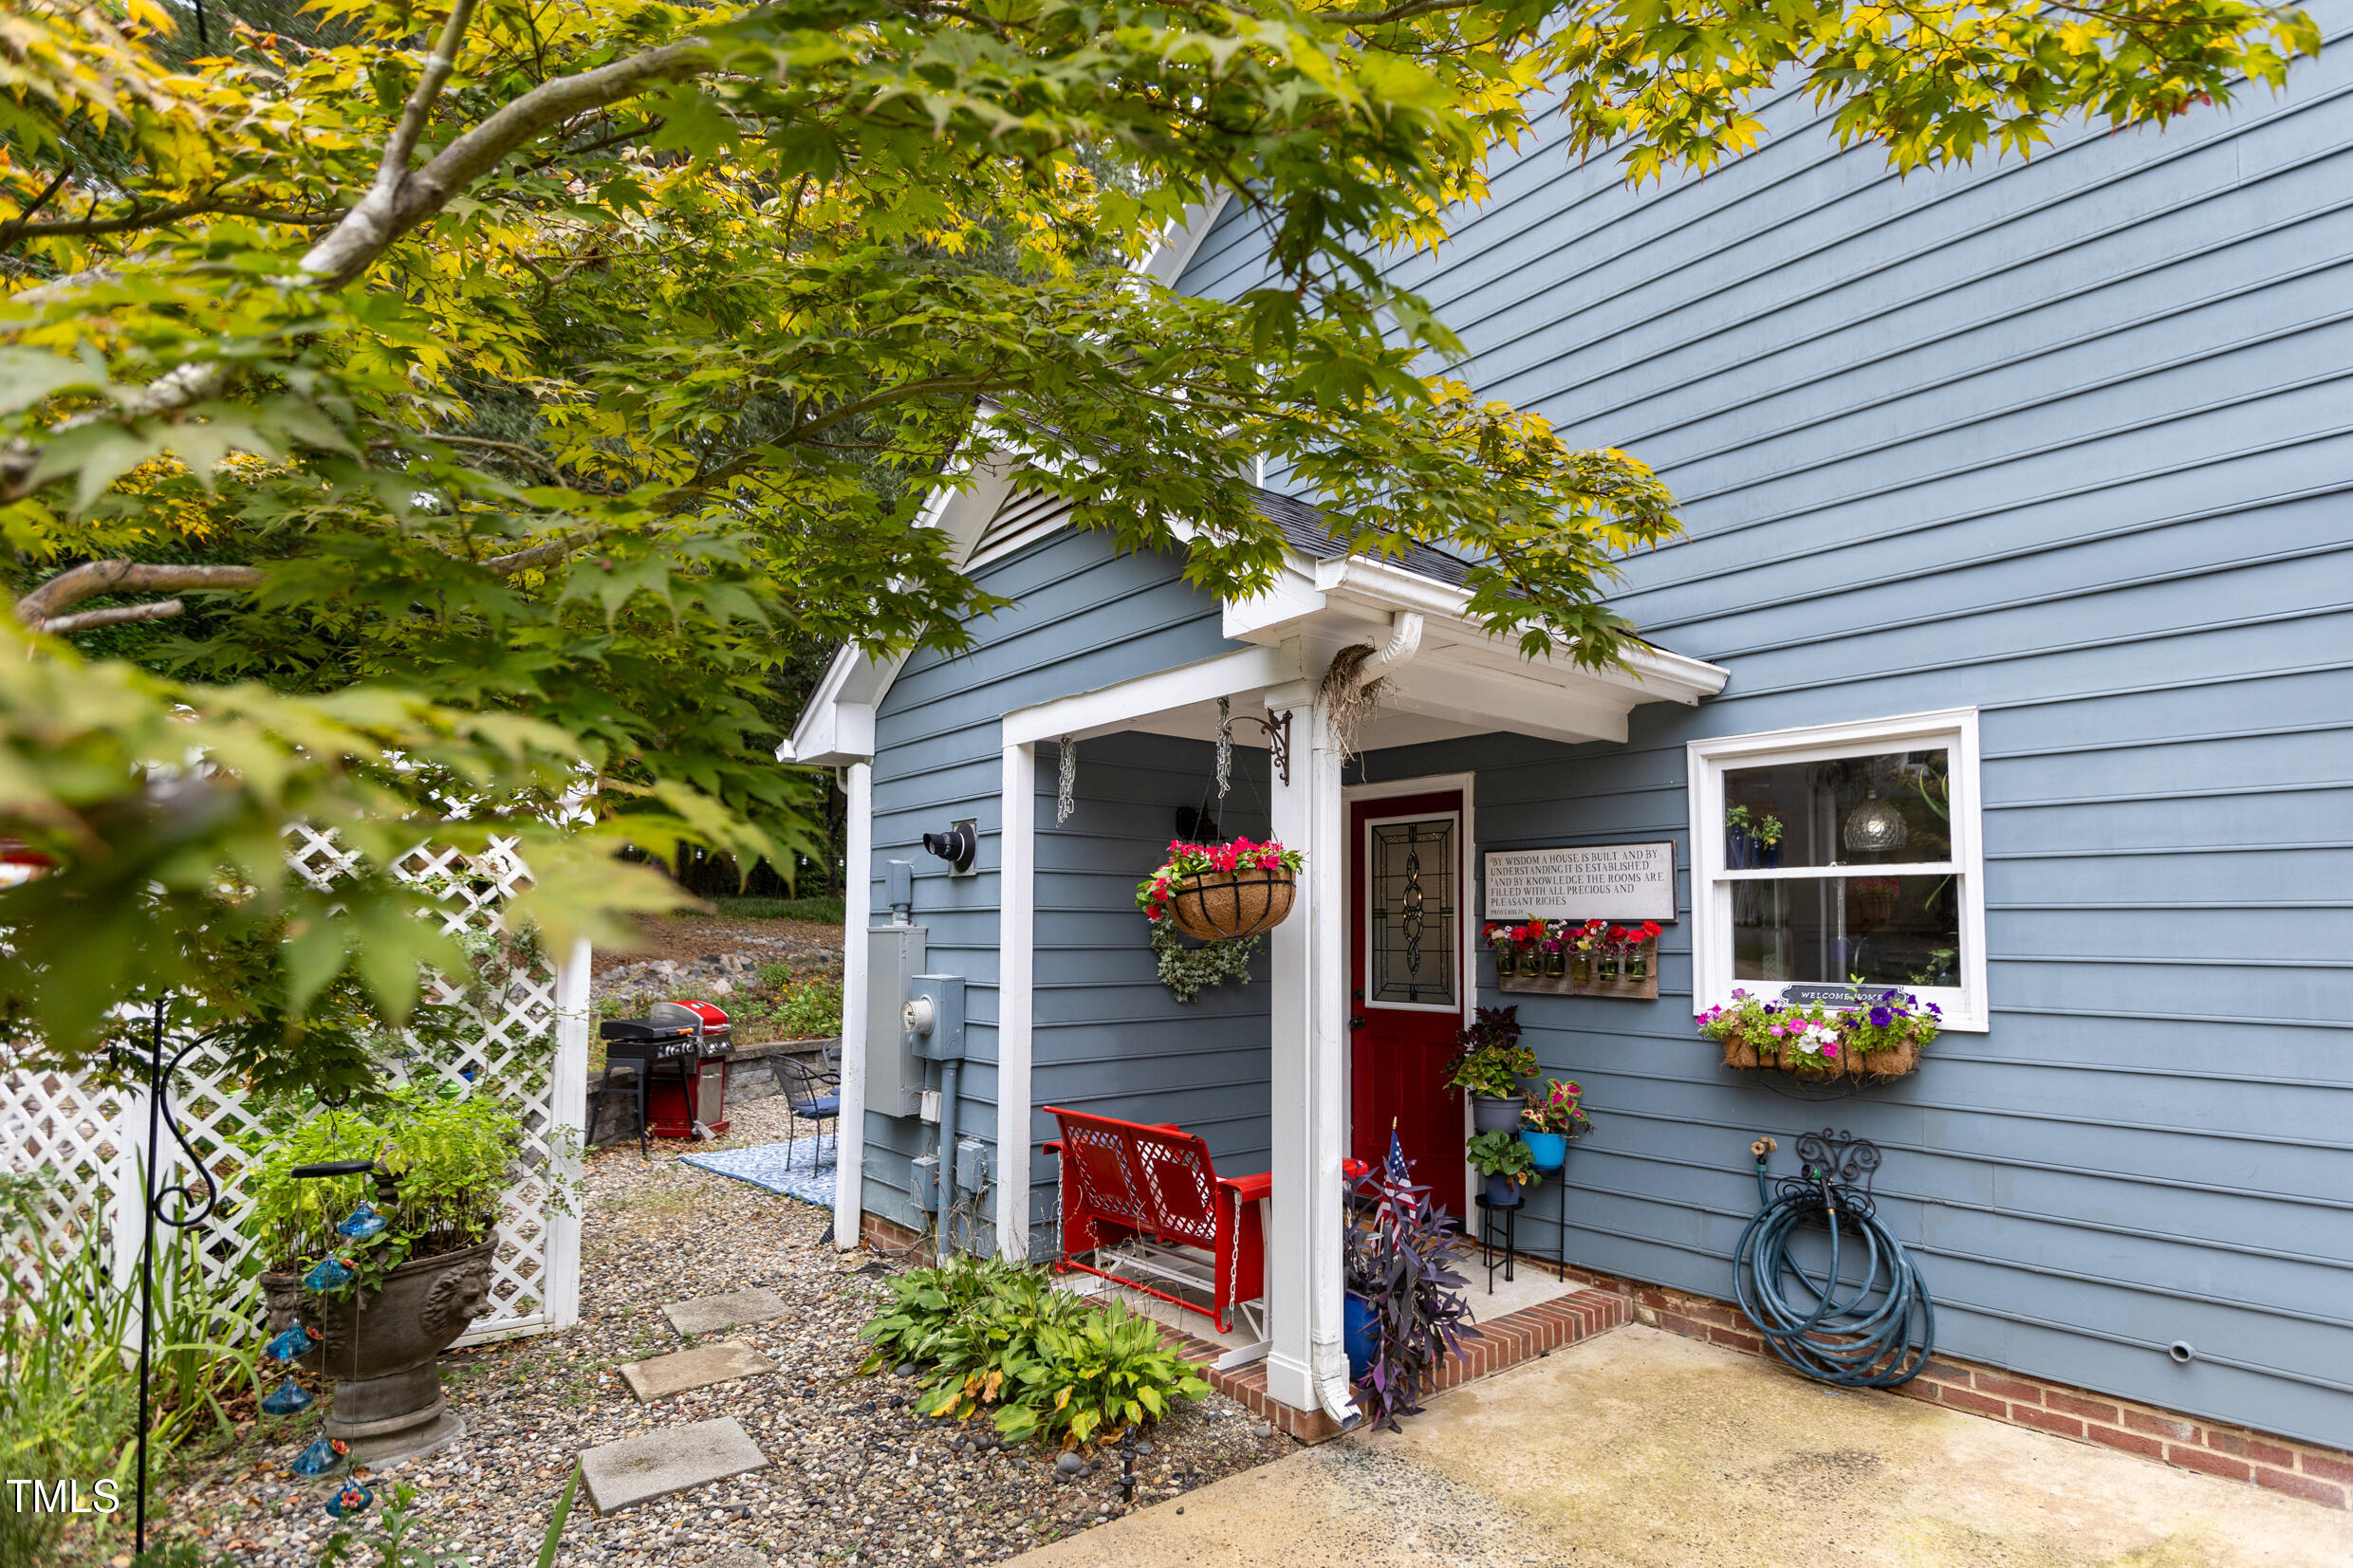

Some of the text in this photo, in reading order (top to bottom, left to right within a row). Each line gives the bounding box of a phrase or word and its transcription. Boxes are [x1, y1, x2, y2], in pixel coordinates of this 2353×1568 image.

[1506, 856, 1539, 865] WISDOM
[1542, 856, 1547, 864] A
[1549, 854, 1579, 863] HOUSE
[1582, 853, 1589, 862] IS
[1622, 850, 1643, 860] AND
[1646, 849, 1658, 859] BY
[1491, 861, 1649, 876] UNDERSTANDING IT IS ESTABLISHED
[1514, 877, 1523, 886] BY
[1527, 876, 1584, 885] KNOWLEDGE
[1586, 875, 1605, 883] THE
[1608, 873, 1640, 882] ROOMS
[1644, 872, 1664, 881] ARE
[1491, 884, 1635, 896] FILLED WITH ALL PRECIOUS AND
[1491, 896, 1566, 907] PLEASANT RICHES
[1801, 991, 1849, 1001] WELCOME
